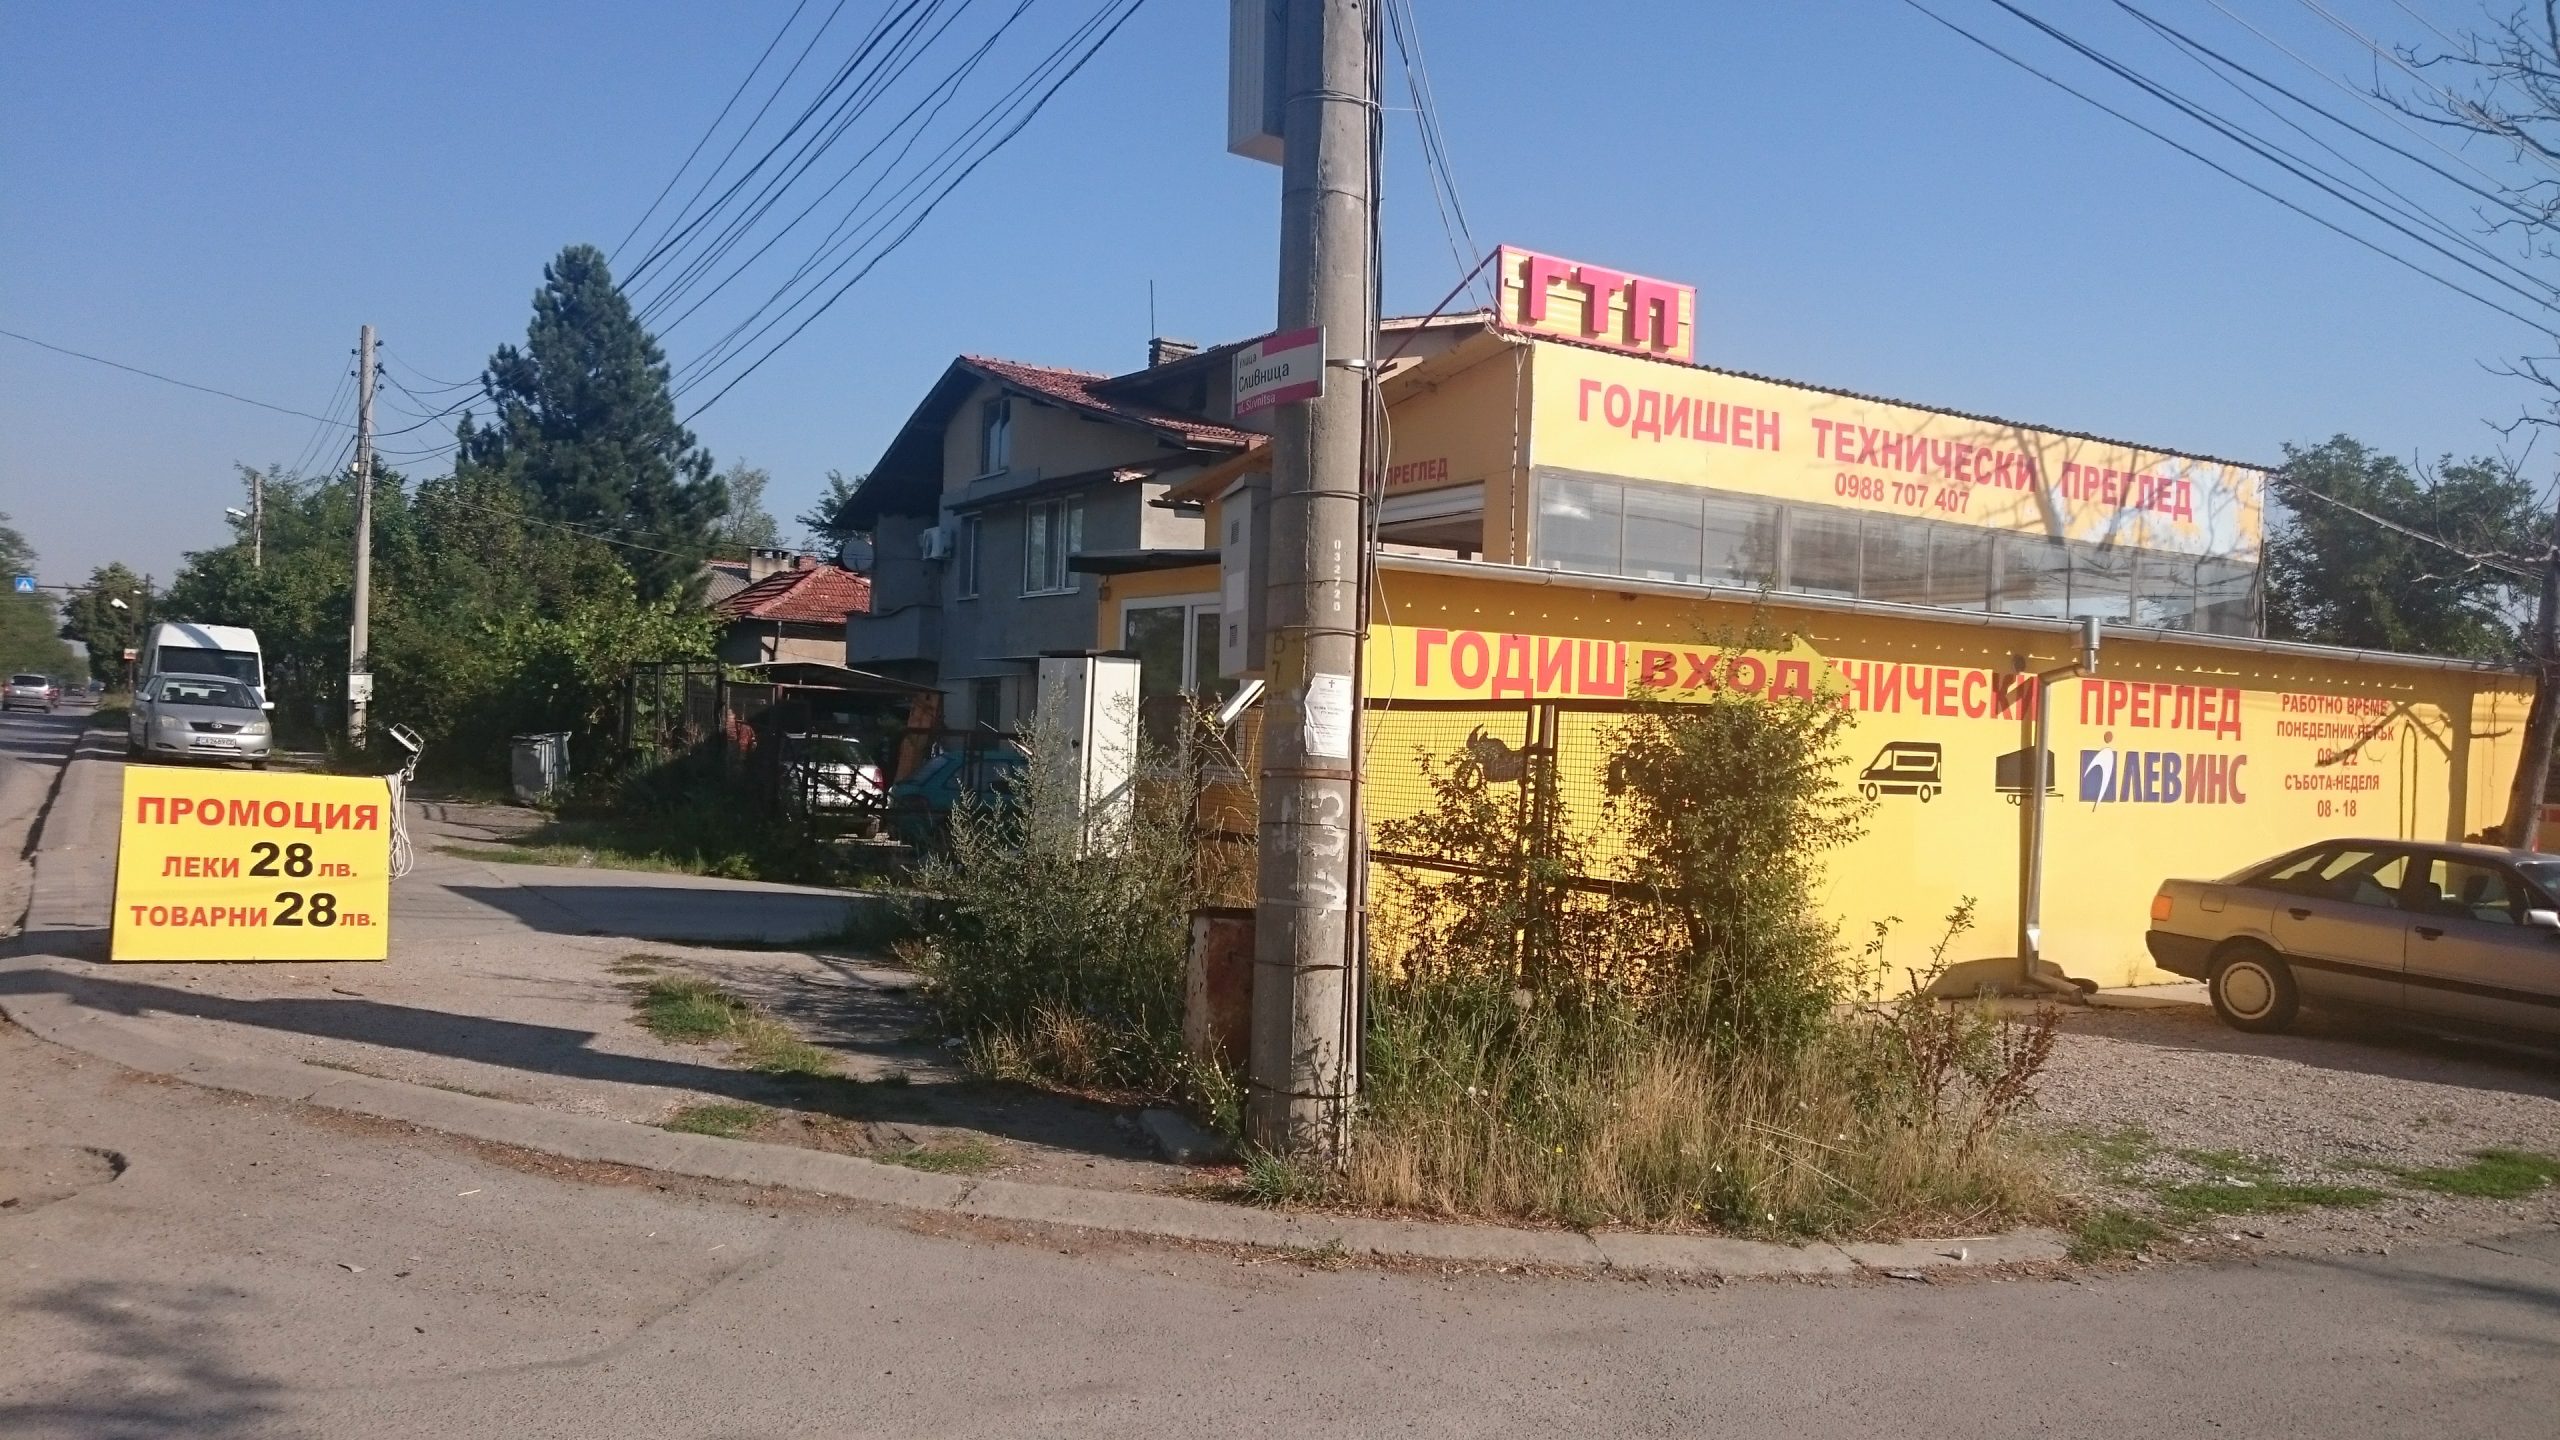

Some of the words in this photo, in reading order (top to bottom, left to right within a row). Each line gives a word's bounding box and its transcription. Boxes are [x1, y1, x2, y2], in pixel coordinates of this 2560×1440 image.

[1529, 256, 1679, 347] ГТП
[1238, 363, 1290, 393] Сливница
[1578, 378, 1781, 452] ГОДИШЕН
[1811, 417, 2038, 493] ТЕХНИЧЕСКИ
[2061, 461, 2193, 524] ПРЕГЛЕД
[1386, 457, 1449, 487] ПРЕГЛЕД
[1834, 471, 1885, 501] 0988
[1891, 481, 1928, 508] 707
[1934, 489, 1971, 514] 407
[1641, 649, 1813, 702] ВХОД
[2080, 679, 2242, 741] ПРЕГЛЕД
[2282, 694, 2343, 714] РАБОТНО
[2347, 699, 2388, 717] ВРЕМЕ
[2284, 774, 2380, 793] СЪБОТА-НЕДЕЛЯ
[137, 796, 378, 834] ПРОМОЦИЯ
[2317, 799, 2332, 818] 08
[2342, 799, 2357, 818] 18
[162, 856, 239, 878] ЛЕКИ
[248, 842, 313, 877] 28
[130, 906, 267, 927] ТОВАРНИ
[273, 892, 337, 927] 28
